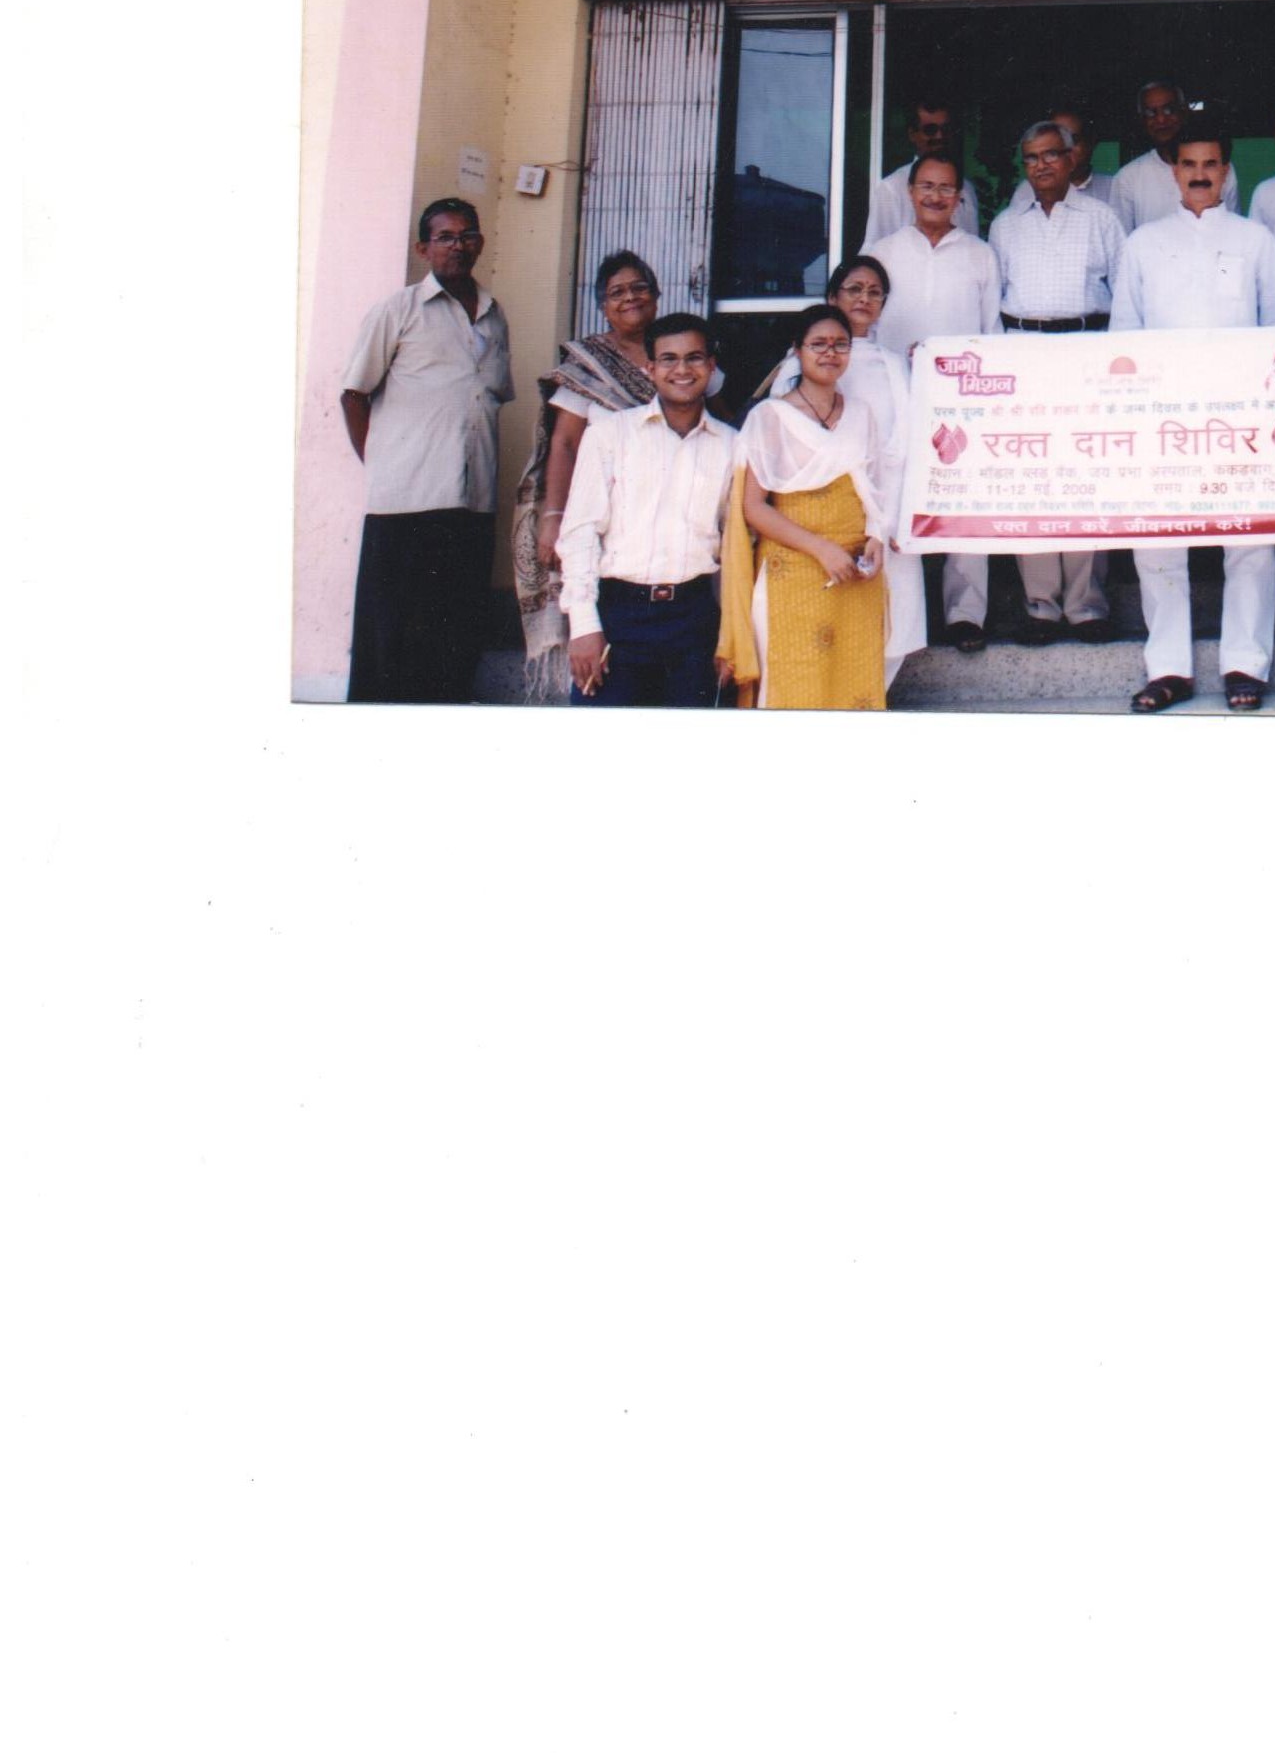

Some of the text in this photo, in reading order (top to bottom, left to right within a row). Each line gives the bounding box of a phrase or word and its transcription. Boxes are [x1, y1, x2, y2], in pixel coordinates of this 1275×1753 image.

[961, 374, 1013, 394] मिशन
[981, 418, 1260, 458] रक्त दान शिविर
[987, 484, 1026, 495] 11-12
[1062, 483, 1096, 495] 2008
[1199, 482, 1228, 494] 9.30
[991, 520, 1029, 533] रक्त
[1038, 520, 1071, 533] दान
[1123, 517, 1207, 534] जीवनदान
